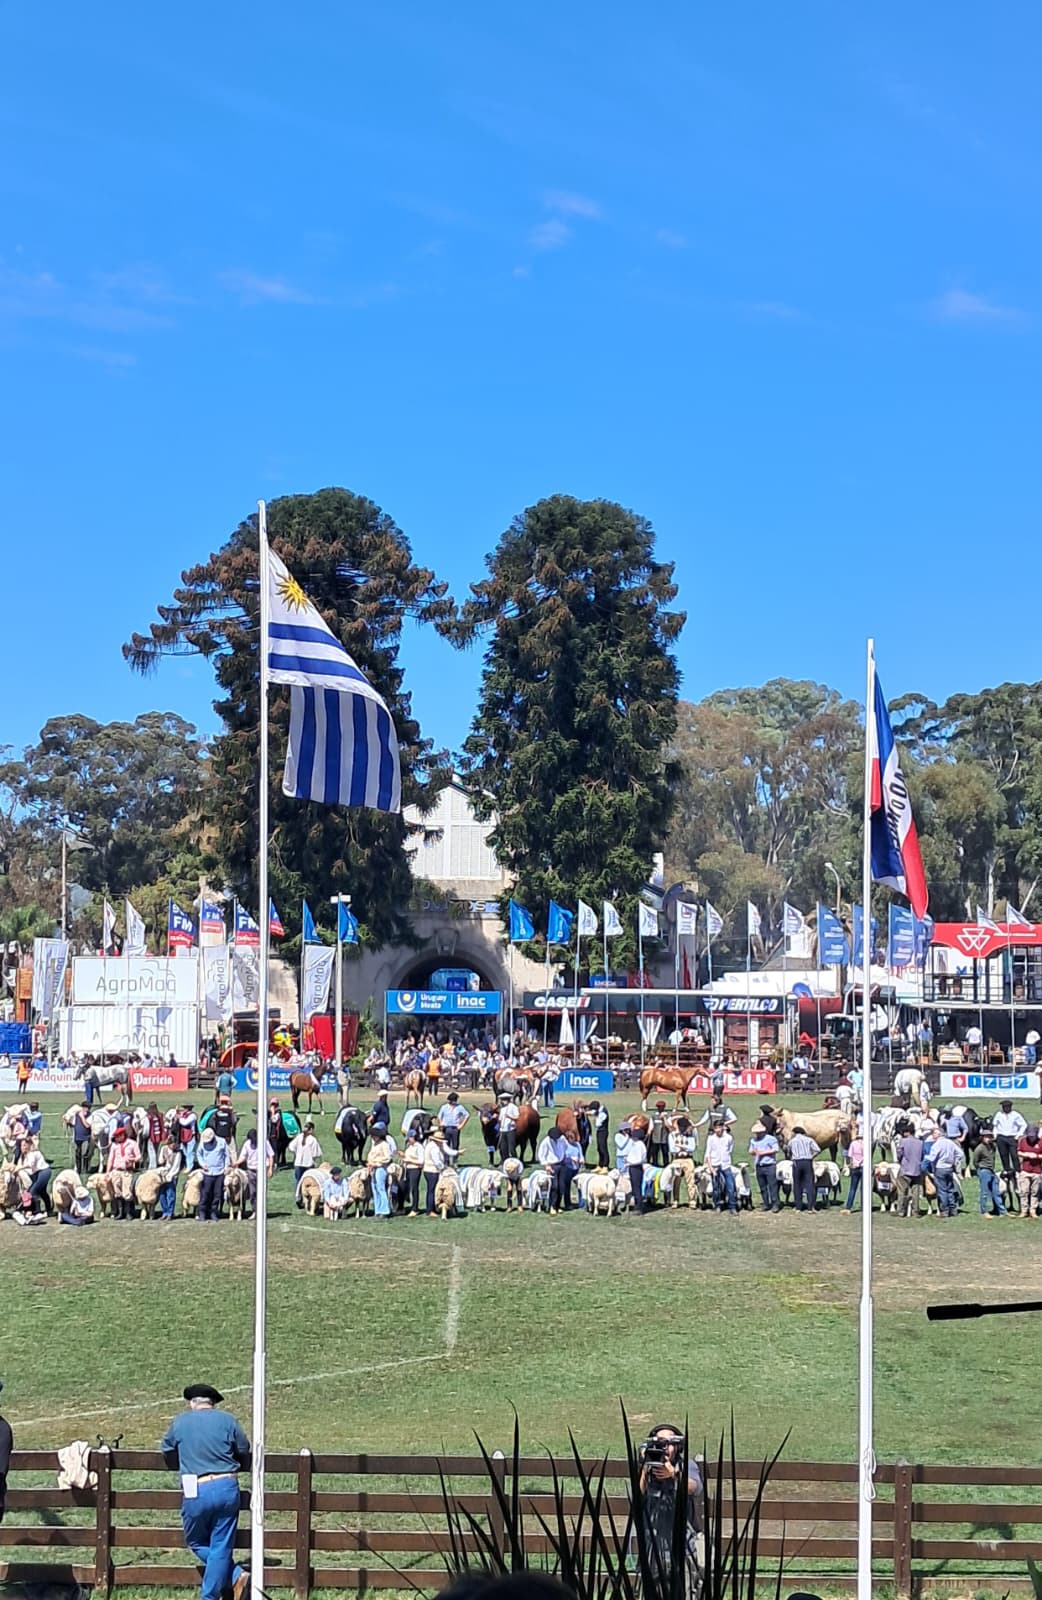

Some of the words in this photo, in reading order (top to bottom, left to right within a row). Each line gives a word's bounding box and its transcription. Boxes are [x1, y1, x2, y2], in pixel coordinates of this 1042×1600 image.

[173, 915, 193, 932] FM
[96, 976, 176, 995] AgroMaq
[457, 994, 486, 1006] inac
[133, 1072, 173, 1089] Patricia
